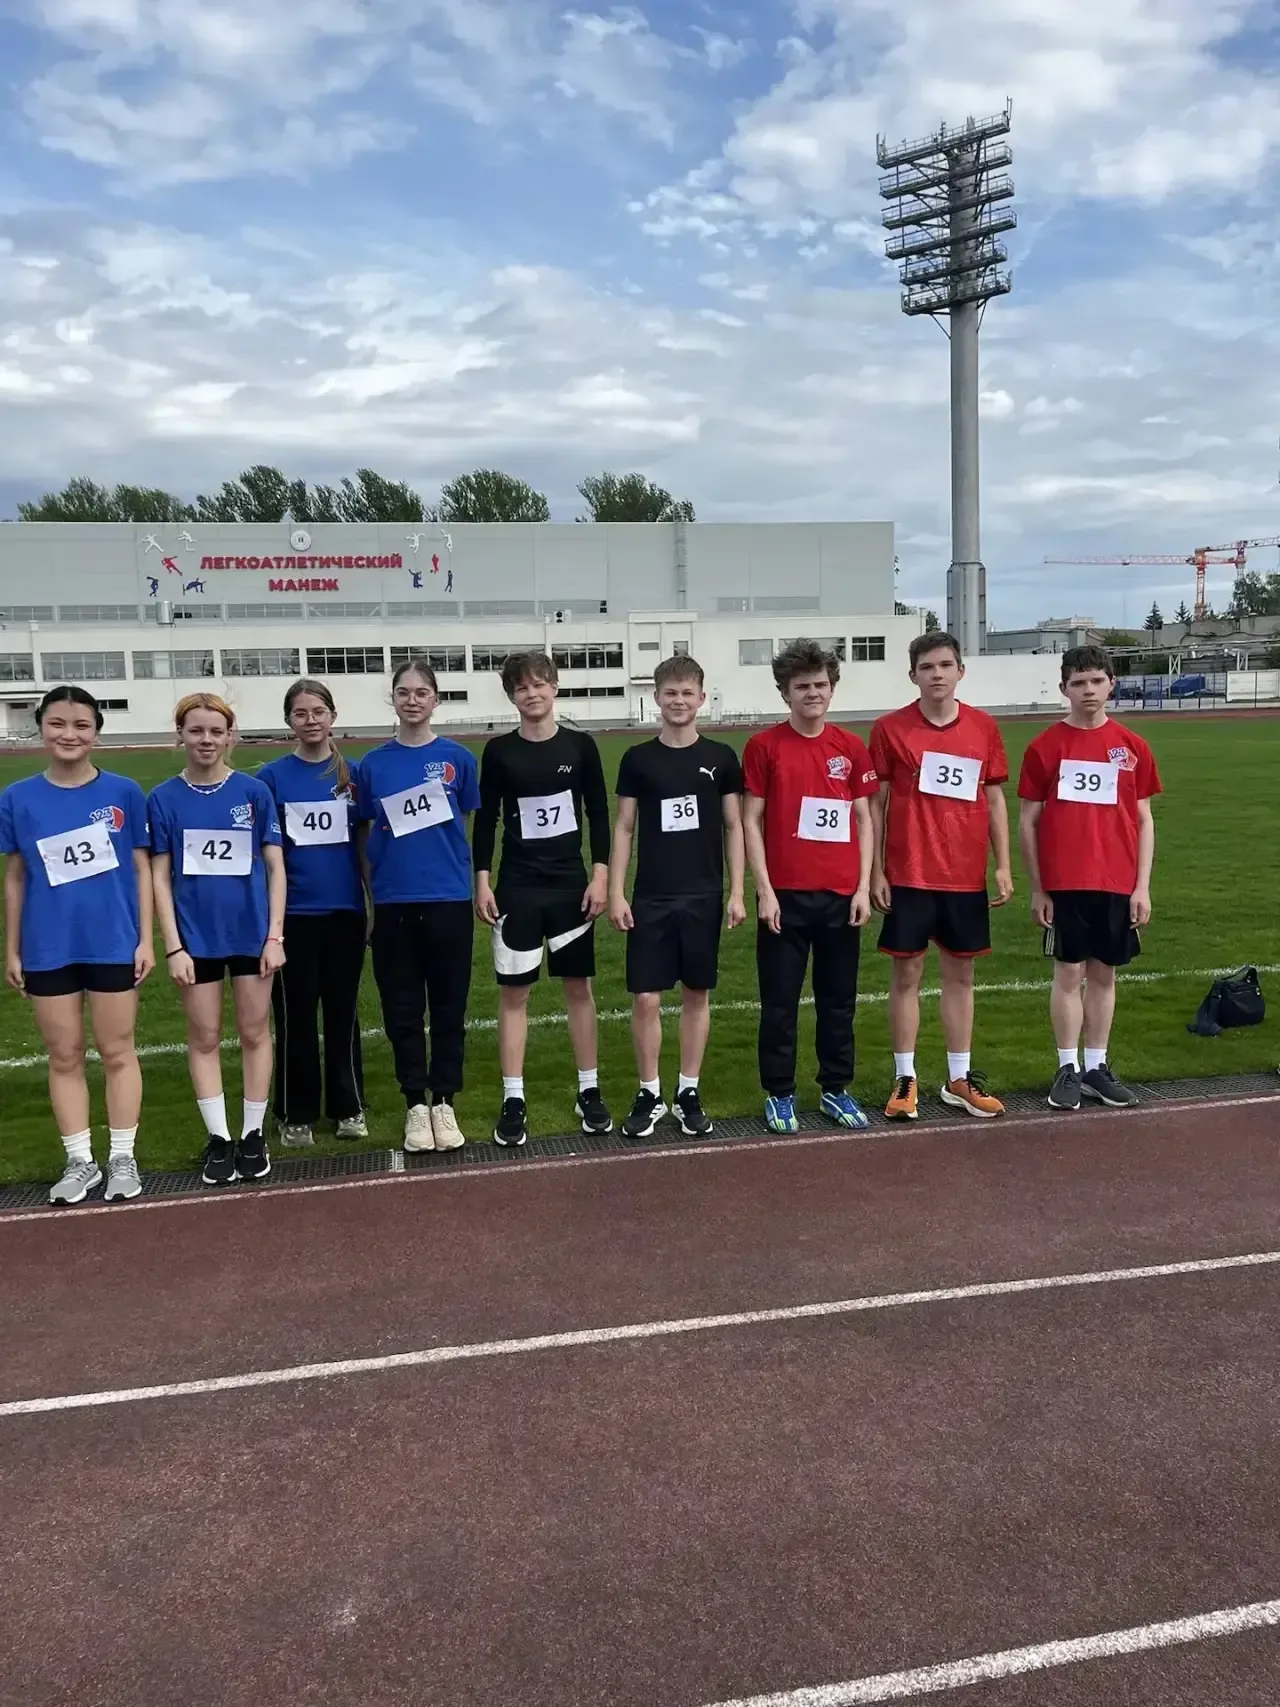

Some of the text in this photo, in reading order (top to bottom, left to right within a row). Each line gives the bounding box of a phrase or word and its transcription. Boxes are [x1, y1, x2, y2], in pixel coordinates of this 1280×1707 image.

[200, 553, 403, 570] ЛЕГКОАТЛЕТИЧЕСКИЙ
[268, 579, 339, 592] МАНЕЖ
[557, 764, 573, 774] FN
[935, 765, 964, 787] 35
[1073, 772, 1102, 792] 39
[403, 794, 432, 817] 44
[673, 802, 695, 819] 36
[303, 811, 332, 831] 40
[535, 806, 561, 827] 37
[815, 808, 839, 829] 38
[63, 841, 96, 866] 43
[201, 839, 233, 860] 42
